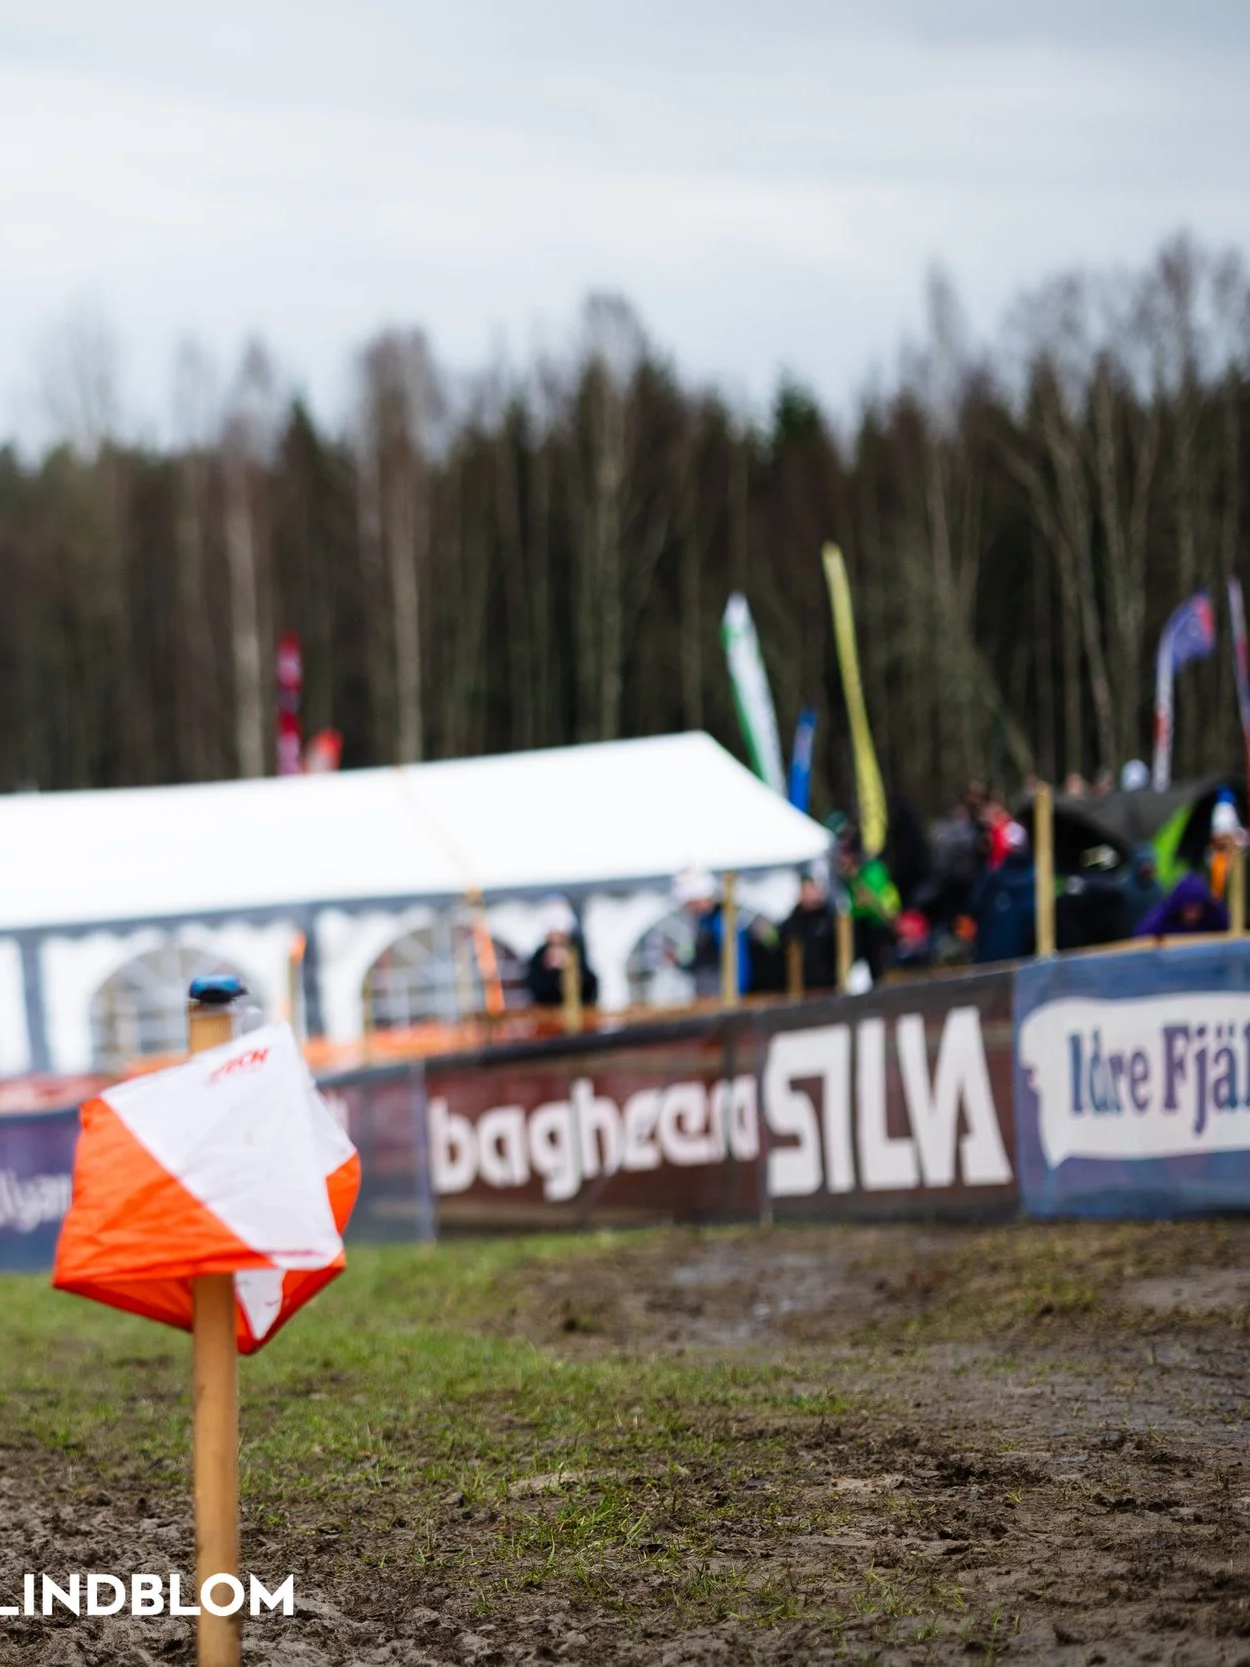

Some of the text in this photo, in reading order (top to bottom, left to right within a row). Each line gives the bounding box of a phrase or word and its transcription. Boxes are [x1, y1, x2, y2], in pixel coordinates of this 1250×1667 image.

[765, 1005, 1014, 1197] SILVA
[1068, 1026, 1148, 1115] Idre
[429, 1076, 760, 1200] bagheera
